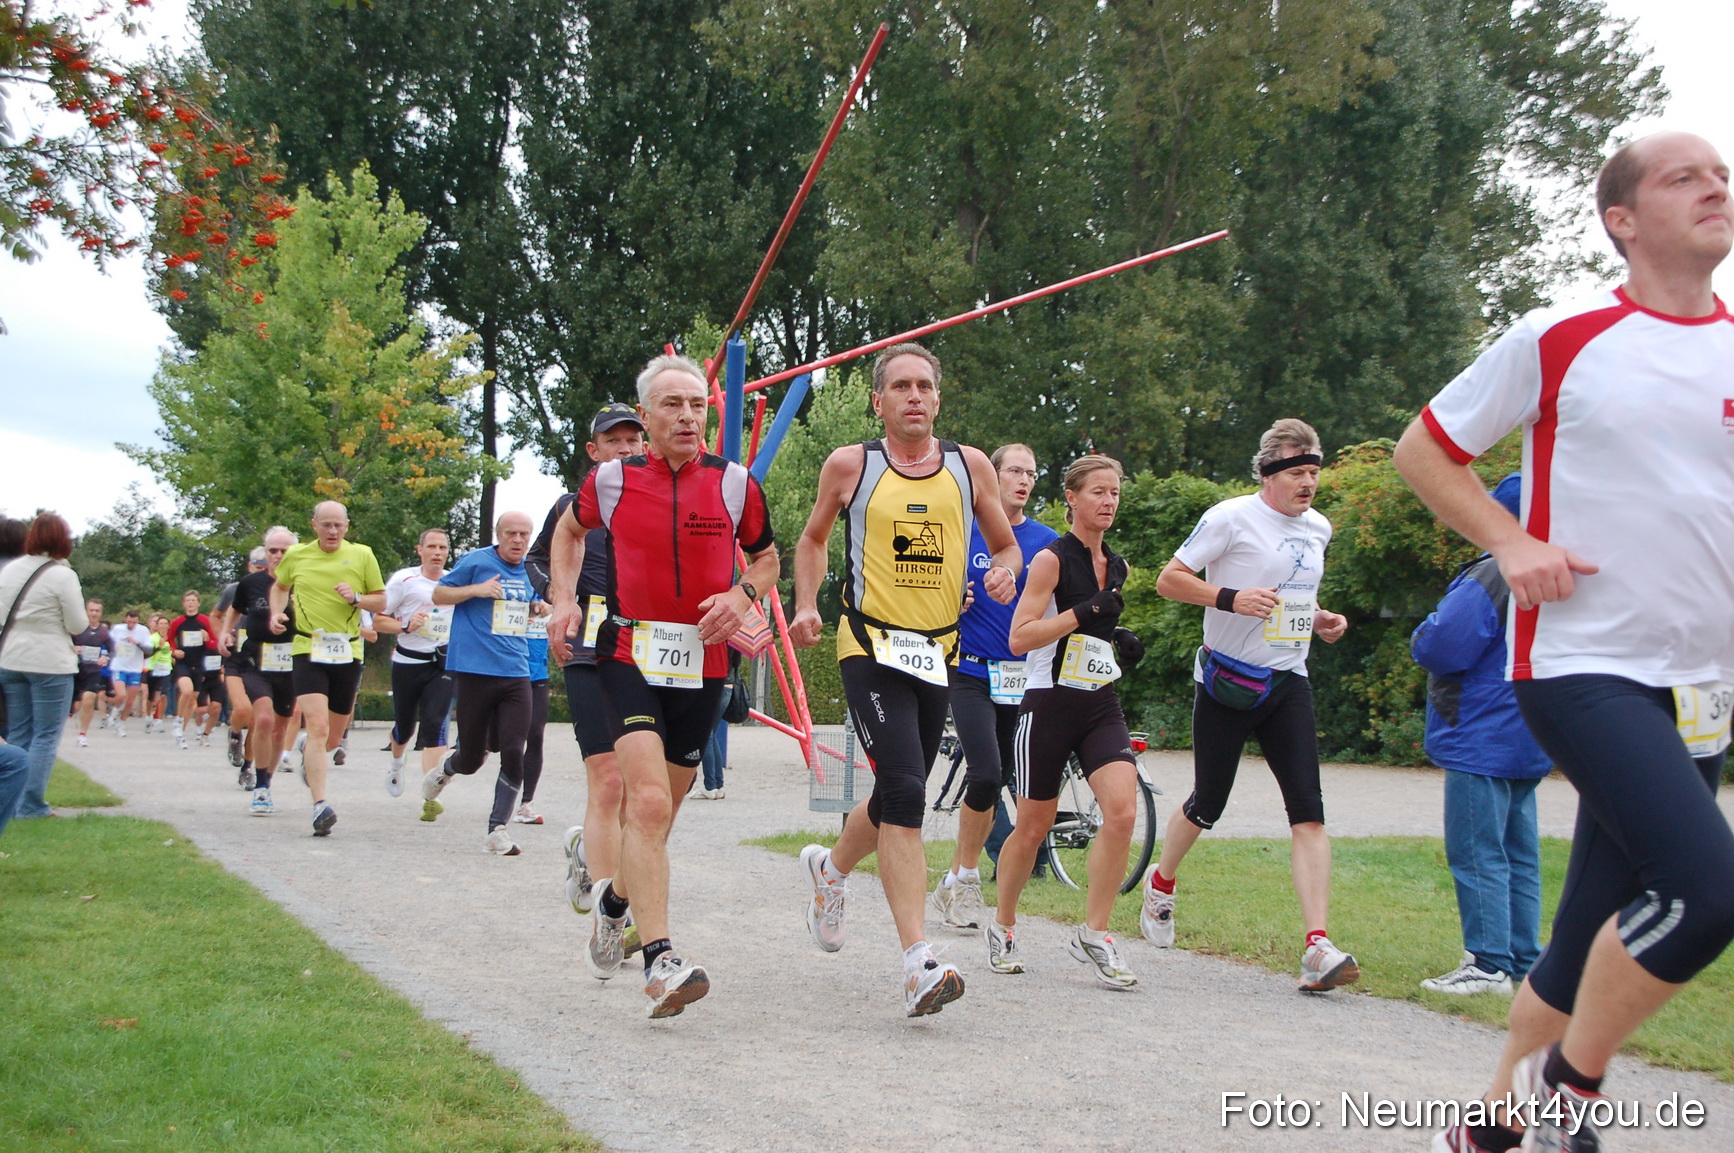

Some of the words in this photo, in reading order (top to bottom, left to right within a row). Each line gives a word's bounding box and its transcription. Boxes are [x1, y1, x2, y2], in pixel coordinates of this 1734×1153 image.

[895, 563, 942, 575] HIRSCH
[895, 578, 941, 586] APOTHEKE
[508, 614, 524, 625] 740
[1289, 617, 1311, 631] 199
[433, 624, 447, 633] 469
[653, 628, 683, 641] Albert
[892, 635, 925, 649] Robert
[327, 645, 345, 653] 141
[277, 654, 292, 662] 142
[659, 648, 691, 667] 701
[899, 654, 934, 671] 903
[1087, 659, 1113, 675] 625
[1003, 677, 1027, 688] 2617
